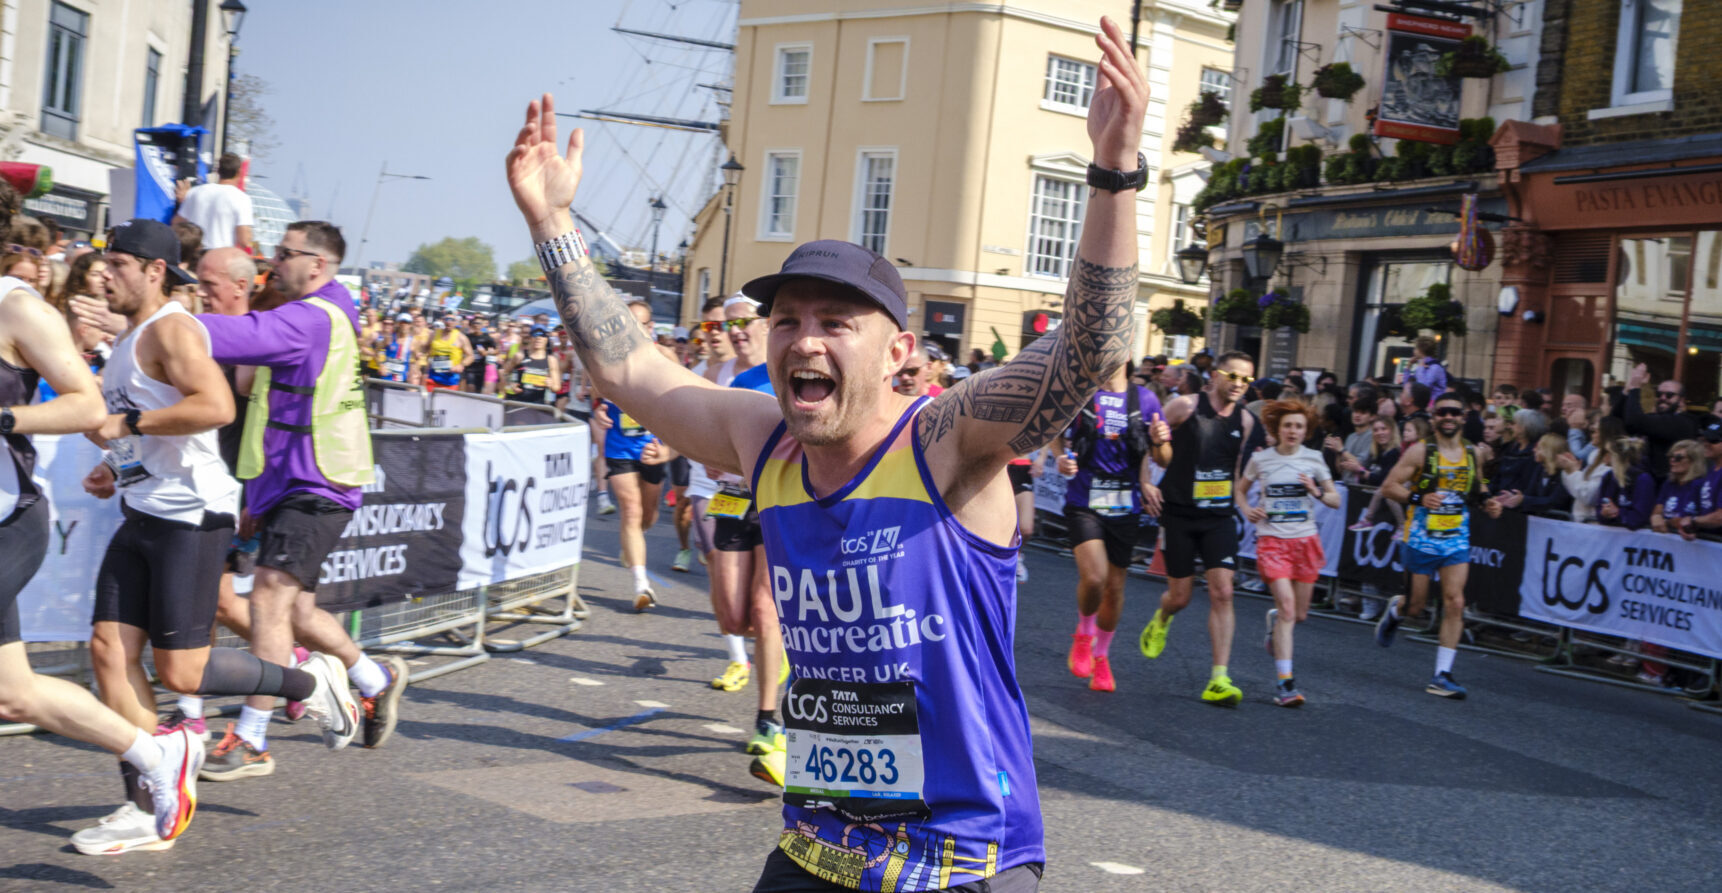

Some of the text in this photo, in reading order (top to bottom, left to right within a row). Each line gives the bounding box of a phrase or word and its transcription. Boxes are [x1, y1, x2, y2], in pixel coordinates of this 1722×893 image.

[1575, 186, 1635, 212] PASTA
[484, 460, 537, 558] tcs
[841, 536, 868, 555] tcs
[842, 557, 867, 567] CHARITY
[877, 554, 889, 562] THE
[889, 551, 905, 560] YEAR
[1623, 546, 1675, 572] TATA
[318, 544, 408, 584] SERVICES
[1542, 537, 1610, 614] tcs
[773, 564, 905, 623] PAUL
[1620, 599, 1694, 631] SERVICES
[787, 687, 828, 724] tcs
[831, 690, 859, 702] TATA
[831, 702, 904, 715] CONSULTANCY
[832, 715, 878, 727] SERVICES
[805, 743, 899, 785] 46283
